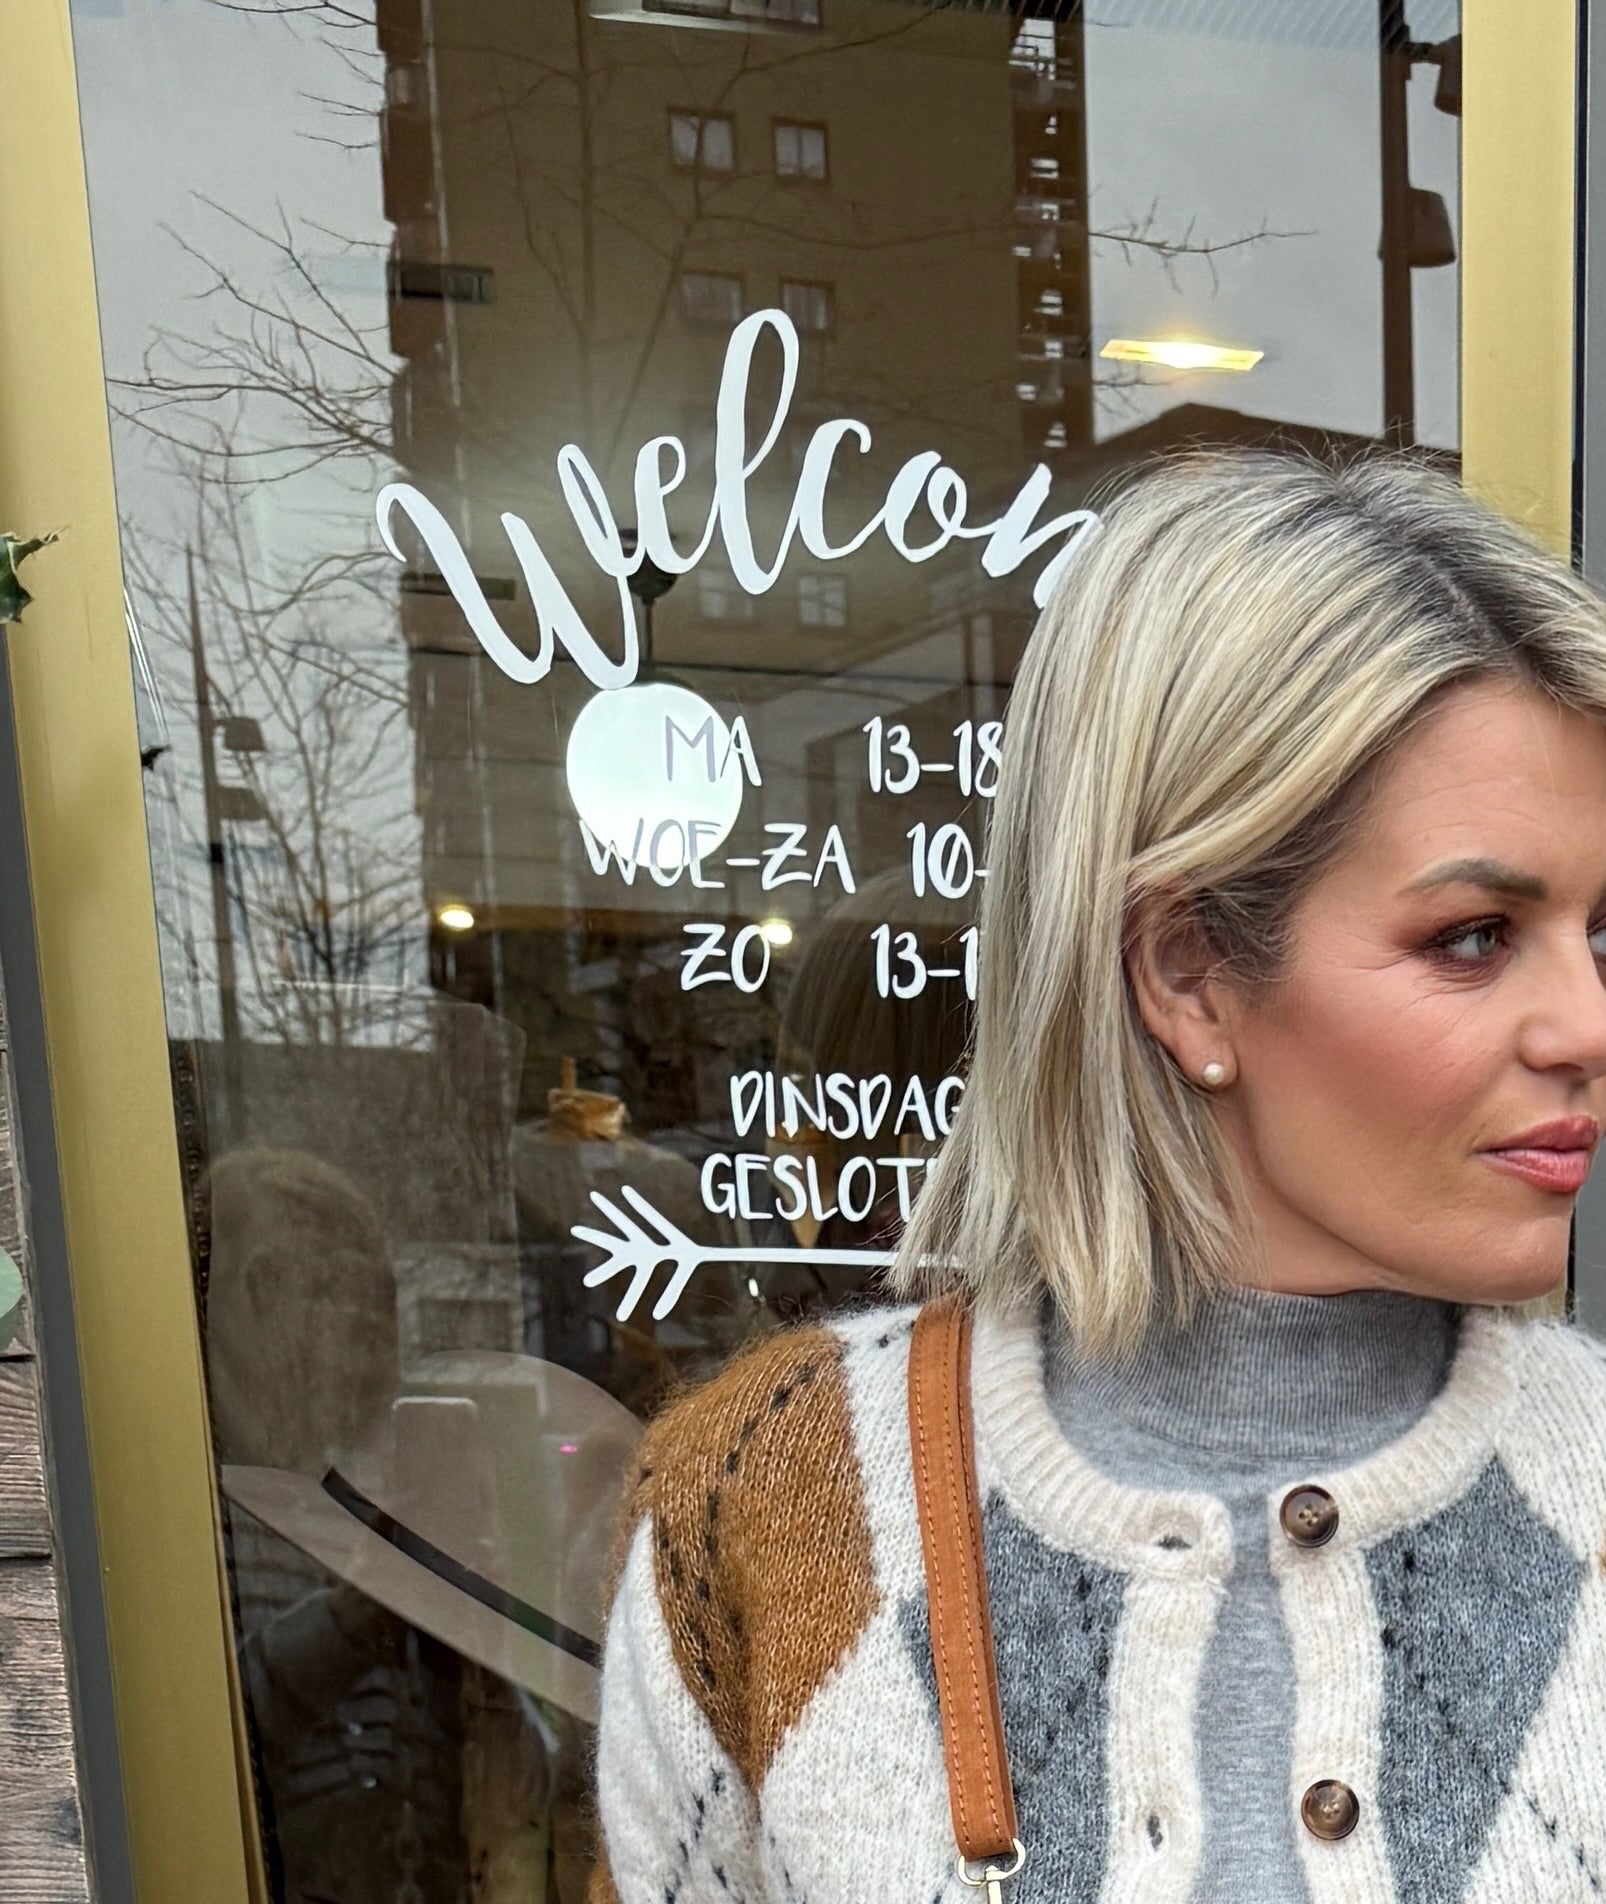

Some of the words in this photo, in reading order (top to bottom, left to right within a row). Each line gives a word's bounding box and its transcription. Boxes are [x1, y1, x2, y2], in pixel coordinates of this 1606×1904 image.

[376, 308, 1103, 690] Welco
[664, 714, 762, 786] MA
[862, 715, 1003, 798] 13-18
[579, 817, 855, 894] WOE-ZA
[906, 821, 991, 899] 10-
[680, 923, 770, 993] ZO
[870, 923, 979, 1001] 13-1
[700, 1152, 940, 1223] GESLOT
